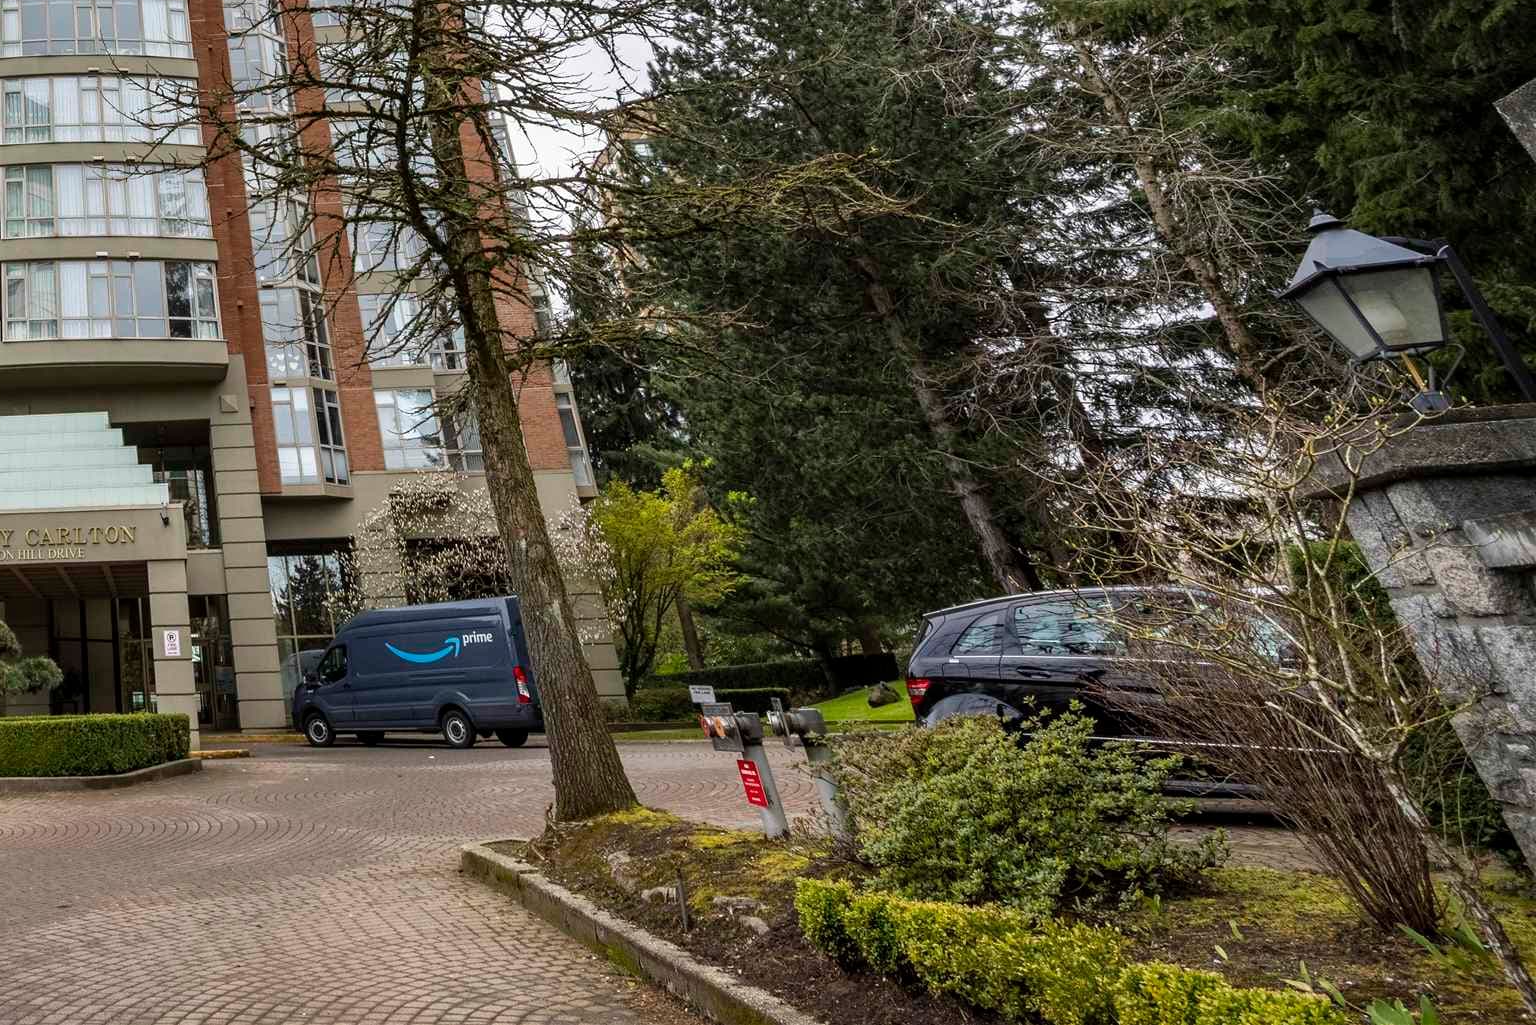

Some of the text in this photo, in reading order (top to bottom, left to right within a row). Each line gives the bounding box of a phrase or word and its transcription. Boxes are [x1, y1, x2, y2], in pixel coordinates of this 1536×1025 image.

[24, 525, 137, 547] CARLTON
[18, 548, 46, 560] HILL
[48, 547, 86, 560] DRIVE
[462, 630, 494, 647] prime
